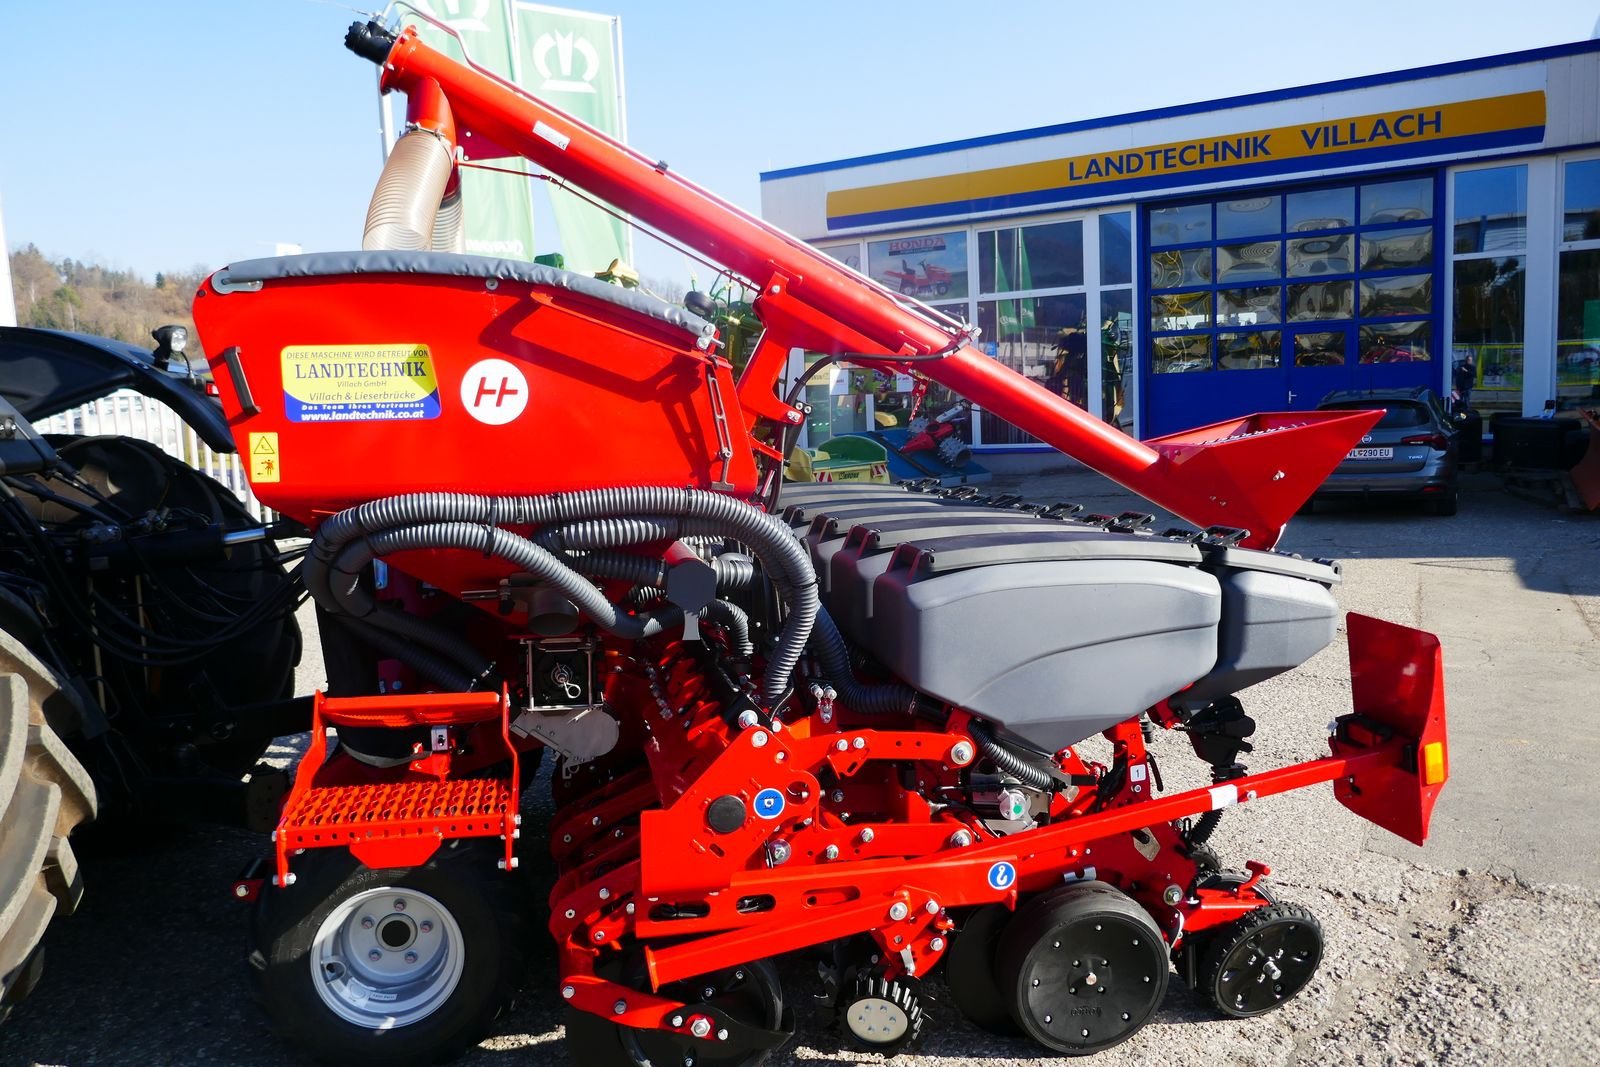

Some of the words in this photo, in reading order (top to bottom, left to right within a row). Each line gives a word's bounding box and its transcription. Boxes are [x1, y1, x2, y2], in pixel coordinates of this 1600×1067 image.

[1068, 134, 1272, 182] LANDTECHNIK
[1299, 110, 1443, 151] VILLACH
[889, 238, 945, 251] HONDA
[286, 351, 309, 359] DIESE
[310, 350, 353, 359] MASCHINE
[354, 350, 375, 358] WIRD
[377, 350, 412, 358] BETREUT
[413, 349, 428, 357] VON
[295, 361, 427, 379] LANDTECHNIK
[309, 392, 342, 401] Villach
[344, 392, 352, 401] &
[354, 391, 416, 401] Lieserbrücke
[301, 410, 425, 421] www.landtechnik.co.at
[1363, 448, 1378, 457] 290
[1379, 448, 1390, 457] EU
